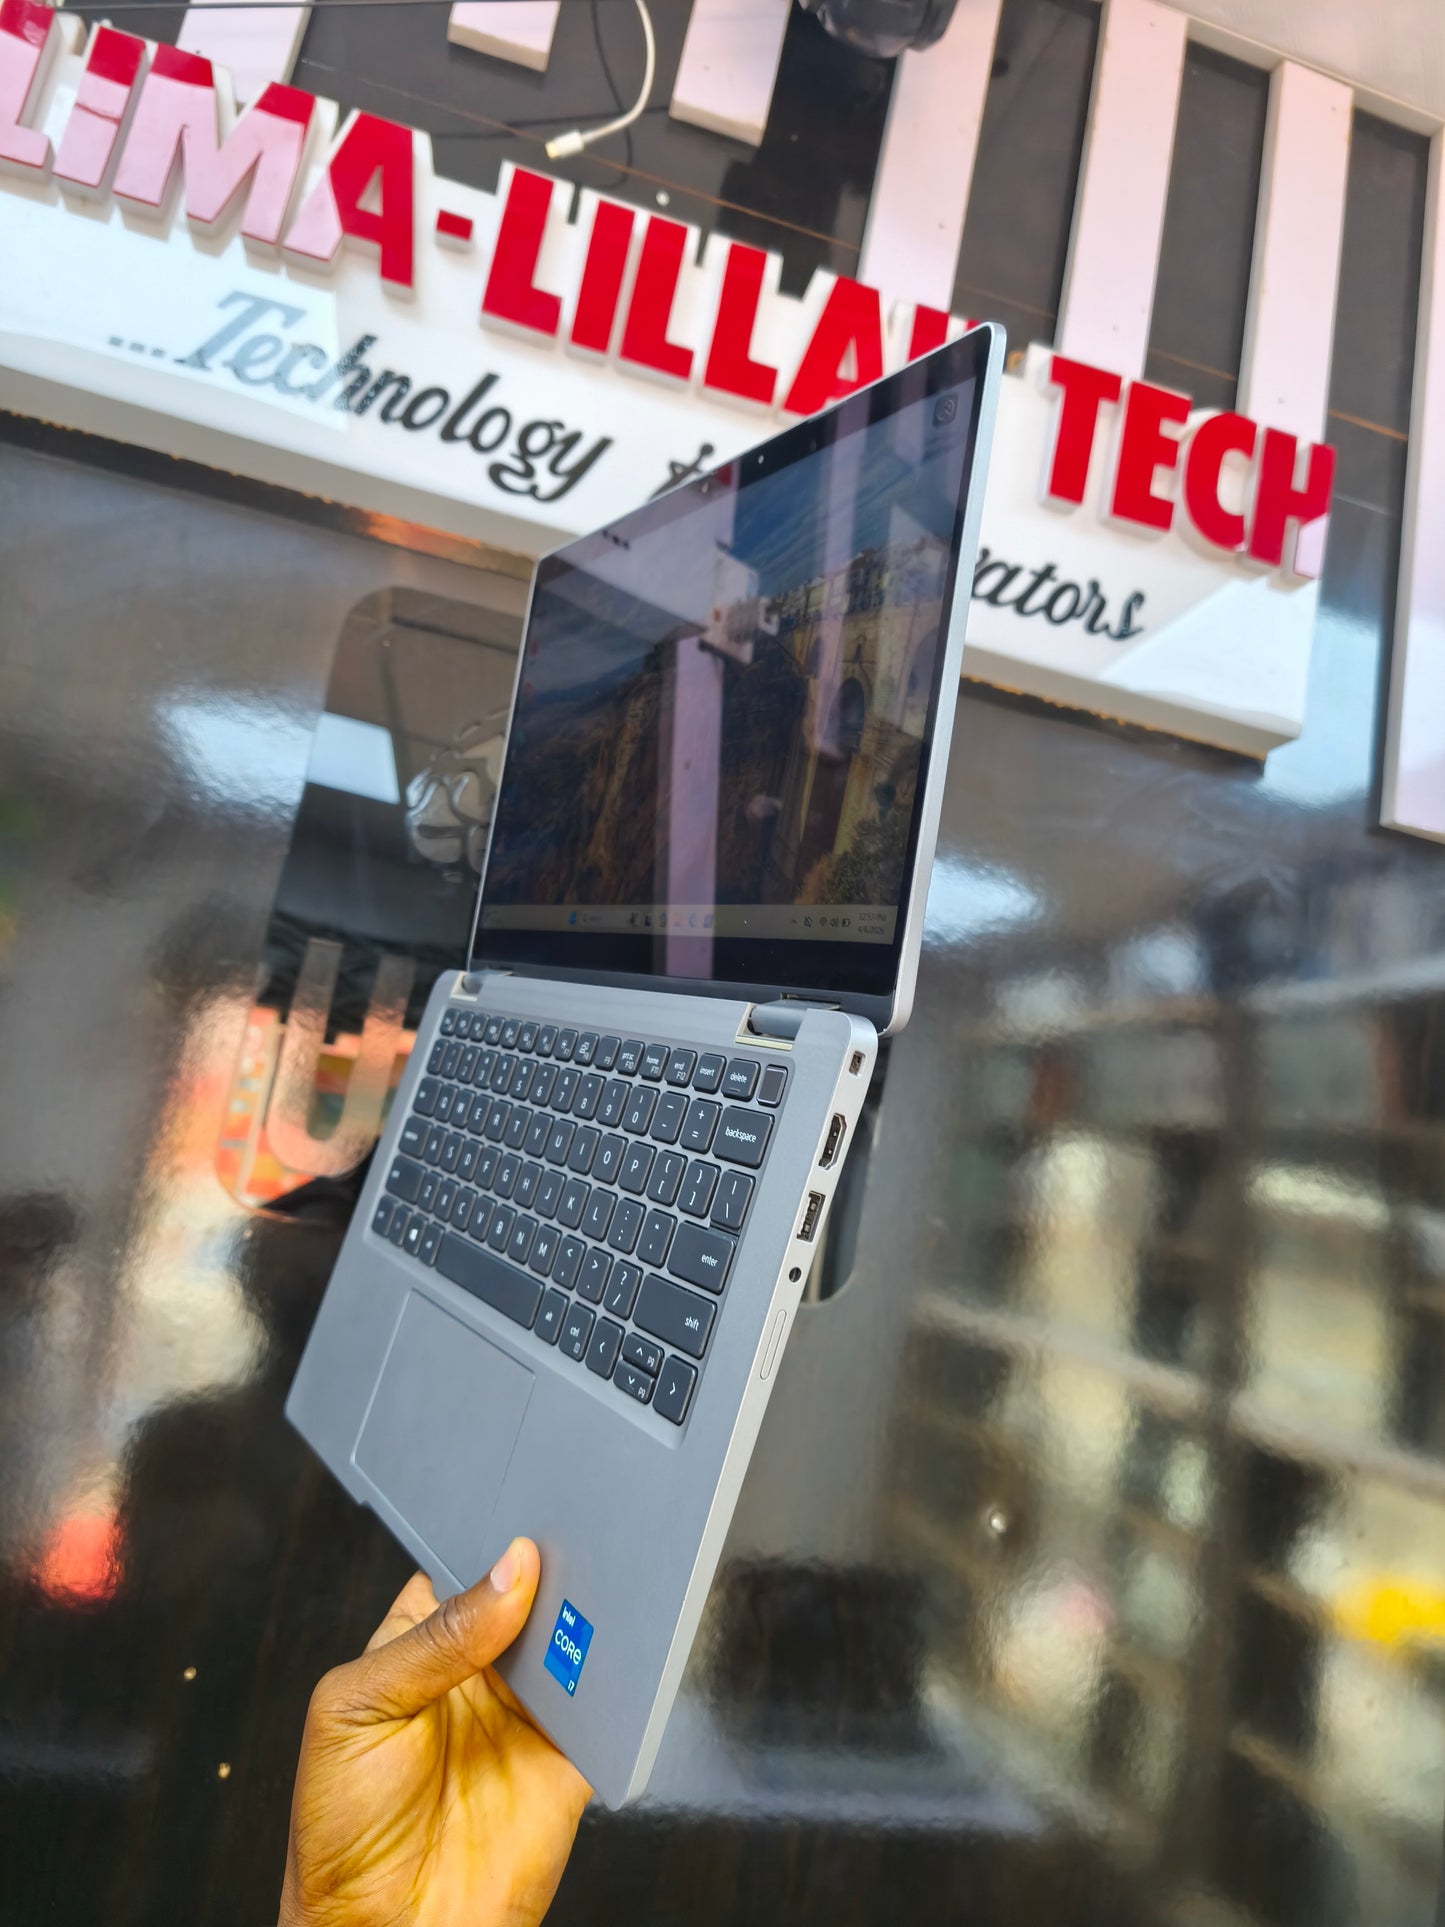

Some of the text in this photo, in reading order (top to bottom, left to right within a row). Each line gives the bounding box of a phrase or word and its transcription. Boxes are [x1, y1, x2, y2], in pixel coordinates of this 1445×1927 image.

[0, 0, 1336, 580] LIMA-LILLA TECH
[646, 1056, 659, 1066] home
[674, 1062, 685, 1071] end
[676, 1072, 686, 1081] F12
[700, 1066, 715, 1076] insert
[730, 1072, 747, 1083] delete
[536, 1086, 543, 1097] 6
[558, 1092, 565, 1102] 7
[580, 1098, 587, 1109] 8
[605, 1104, 612, 1115] 9
[475, 1108, 482, 1120] E
[494, 1114, 500, 1126] R
[514, 1121, 520, 1132] T
[535, 1128, 541, 1139] Y
[725, 1126, 757, 1143] backspace
[556, 1136, 563, 1148] U
[447, 1146, 454, 1159] S
[604, 1151, 611, 1164] O
[464, 1153, 471, 1166] D
[482, 1161, 490, 1172] F
[631, 1160, 639, 1173] P
[503, 1169, 510, 1181] G
[522, 1178, 530, 1190] H
[545, 1188, 552, 1200] J
[458, 1202, 465, 1214] C
[567, 1196, 575, 1210] K
[477, 1212, 484, 1224] V
[592, 1206, 598, 1221] L
[496, 1221, 503, 1234] B
[516, 1231, 525, 1245] N
[539, 1242, 548, 1257] M
[701, 1254, 718, 1267] enter
[620, 1271, 627, 1285] ?
[685, 1316, 700, 1331] shift
[570, 1326, 580, 1337] ctrl
[562, 1606, 576, 1627] intel
